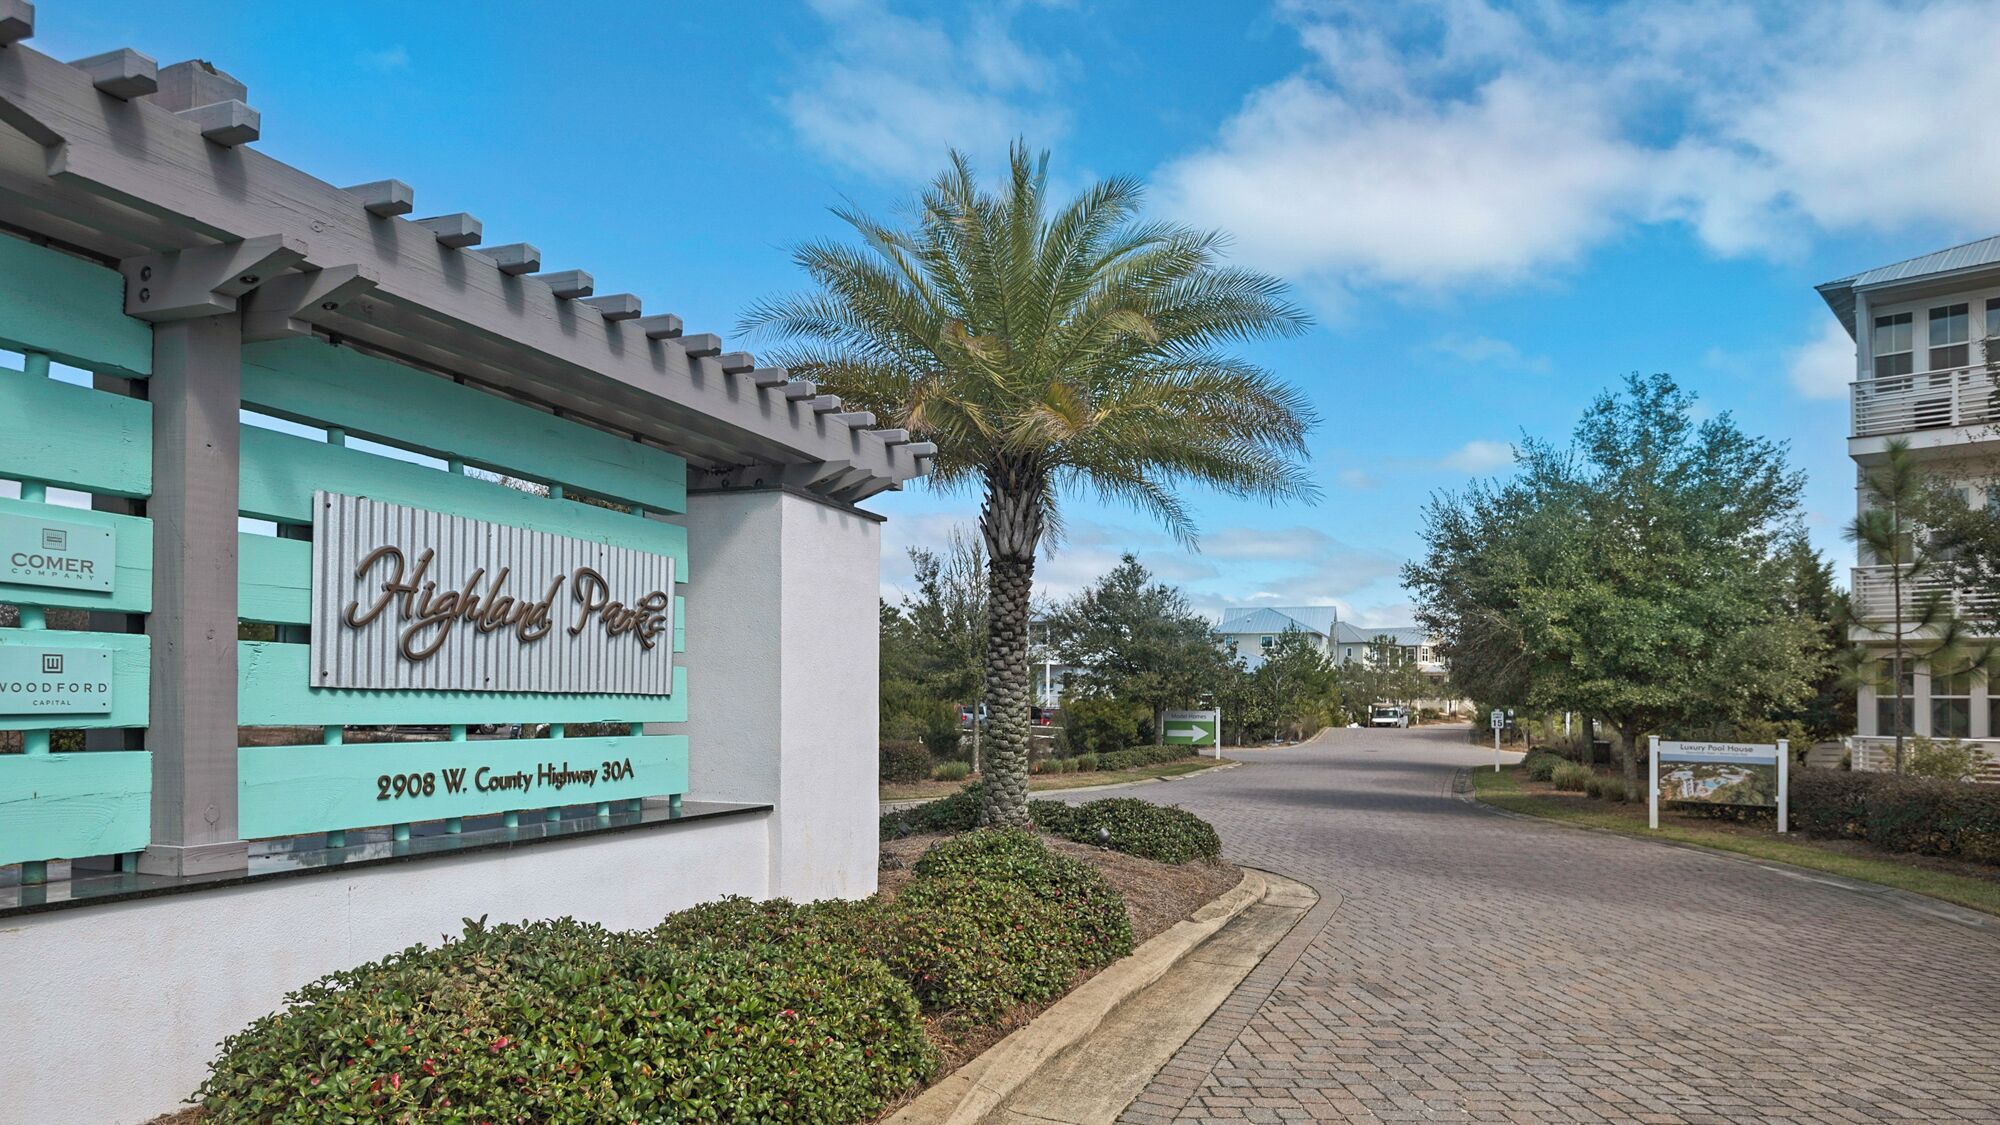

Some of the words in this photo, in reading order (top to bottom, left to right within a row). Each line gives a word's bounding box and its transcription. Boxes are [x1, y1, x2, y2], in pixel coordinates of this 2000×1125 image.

[11, 552, 94, 574] COMER
[11, 567, 94, 580] COMPANY
[344, 545, 566, 662] Highland
[1680, 743, 1705, 751] Luxury
[1707, 744, 1725, 752] Pool
[1727, 745, 1754, 753] House
[376, 773, 436, 800] 2908
[441, 767, 468, 794] W.
[474, 766, 533, 793] County
[537, 761, 598, 790] Highway
[601, 757, 634, 781] 30A
